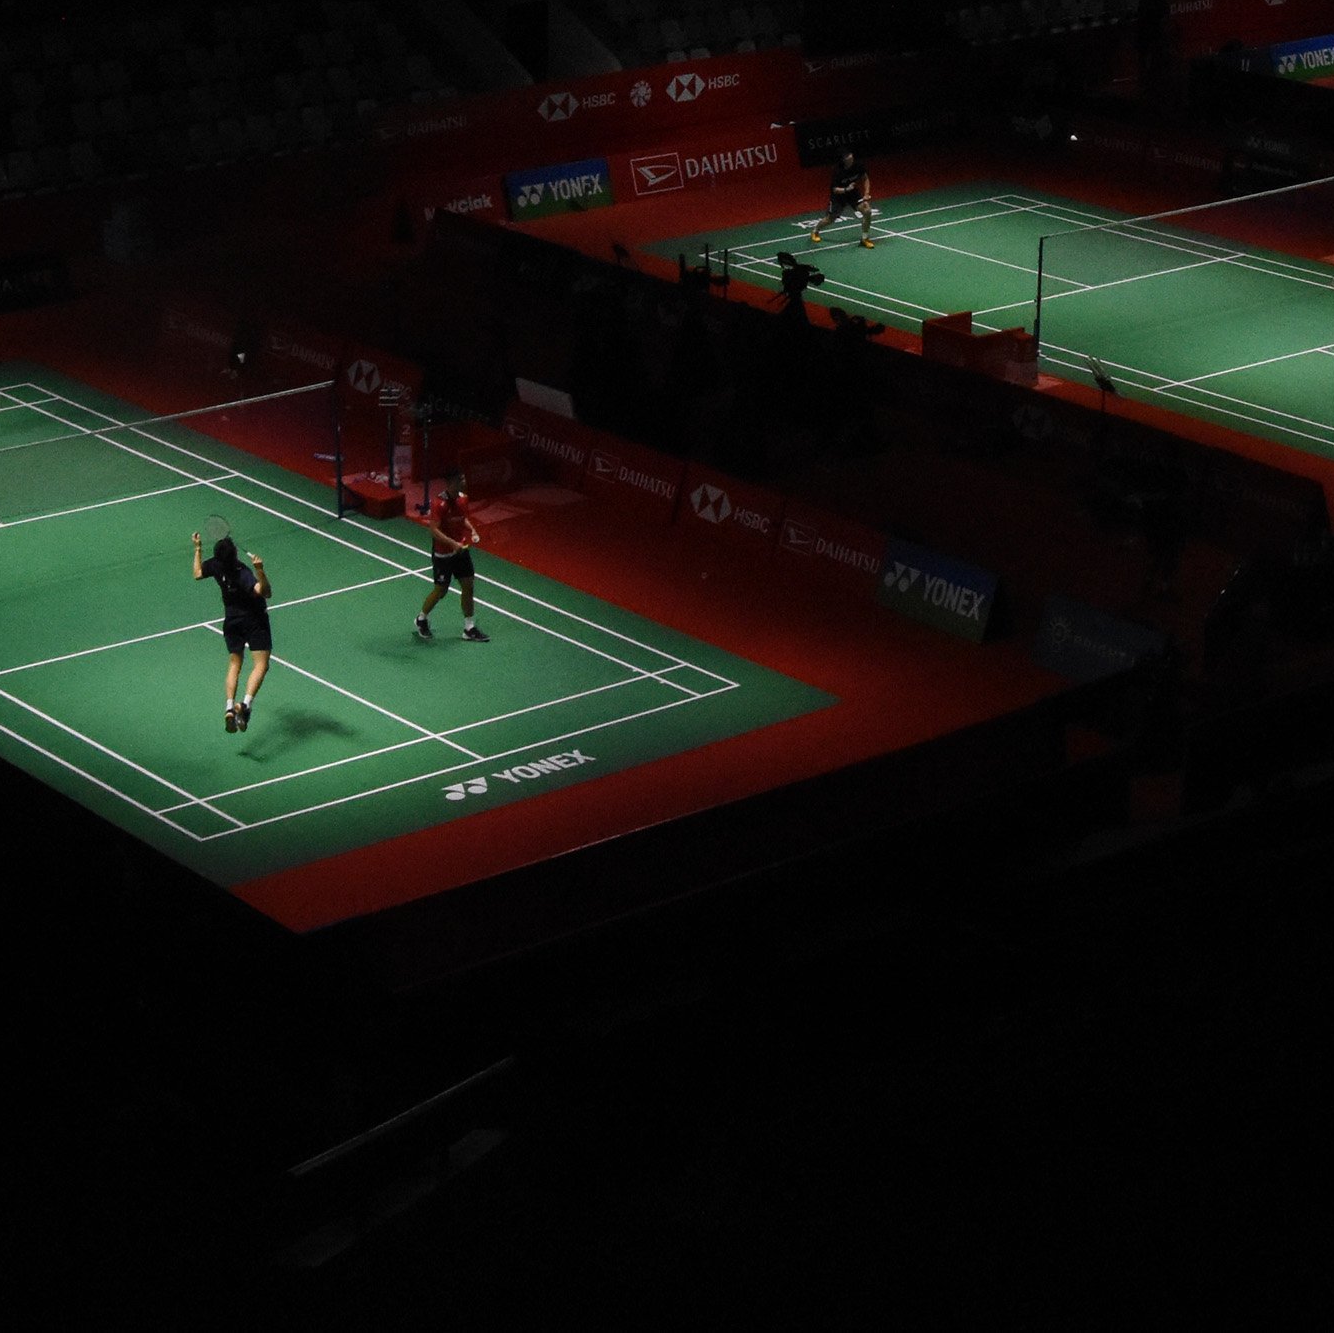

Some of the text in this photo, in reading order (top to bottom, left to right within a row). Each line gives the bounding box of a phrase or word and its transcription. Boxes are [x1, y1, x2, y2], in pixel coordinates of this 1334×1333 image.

[708, 72, 741, 91] HSBC
[581, 91, 618, 111] HSBC
[685, 143, 779, 179] DAIHATSU
[549, 172, 604, 202] YONEX
[529, 432, 585, 466] DAIHATSU
[618, 465, 678, 501] DAIHATSU
[733, 505, 771, 534] HSBC
[814, 537, 882, 575] DAIHATSU
[922, 572, 986, 621] YONEX
[492, 749, 596, 783] YONEX
